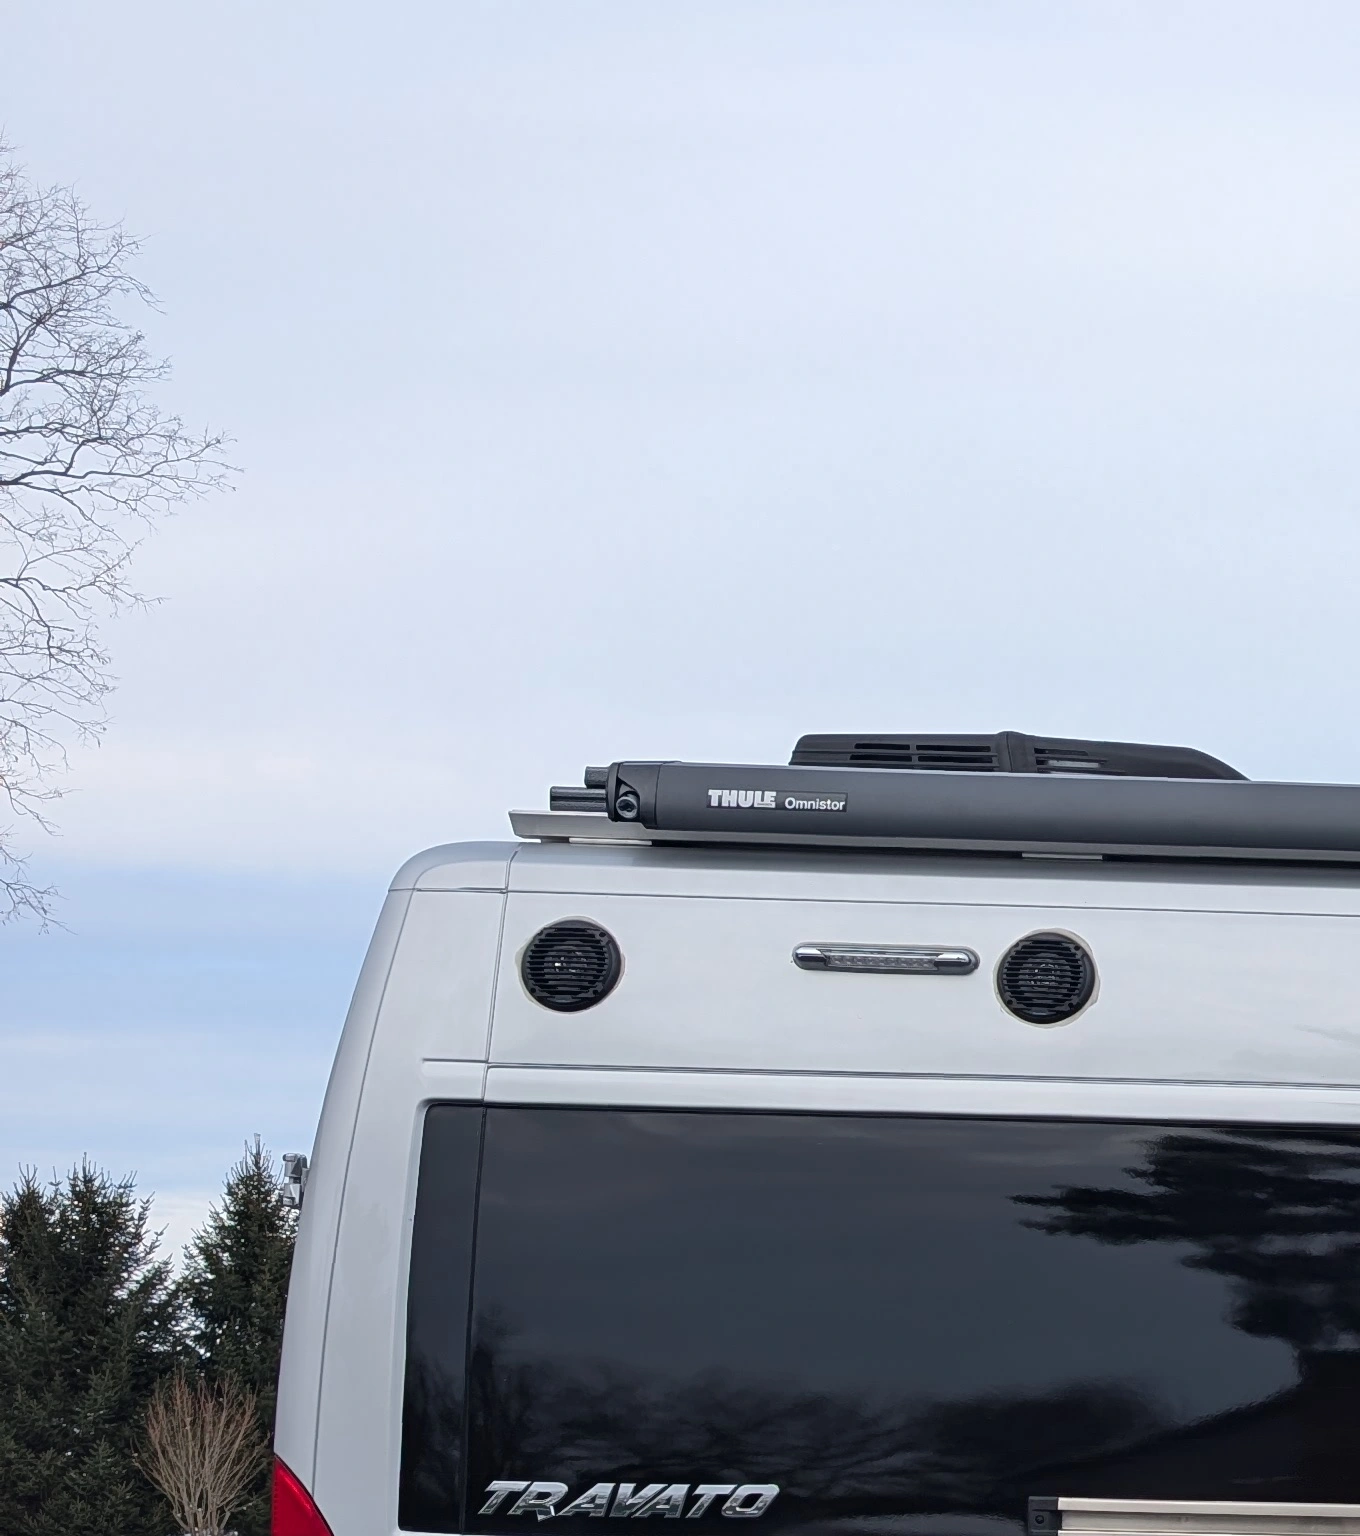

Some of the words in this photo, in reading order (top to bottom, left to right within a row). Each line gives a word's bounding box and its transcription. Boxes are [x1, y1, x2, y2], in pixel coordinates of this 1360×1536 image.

[708, 789, 776, 808] THULE
[785, 797, 845, 811] Omnistor
[477, 1480, 780, 1522] TRAVATO
